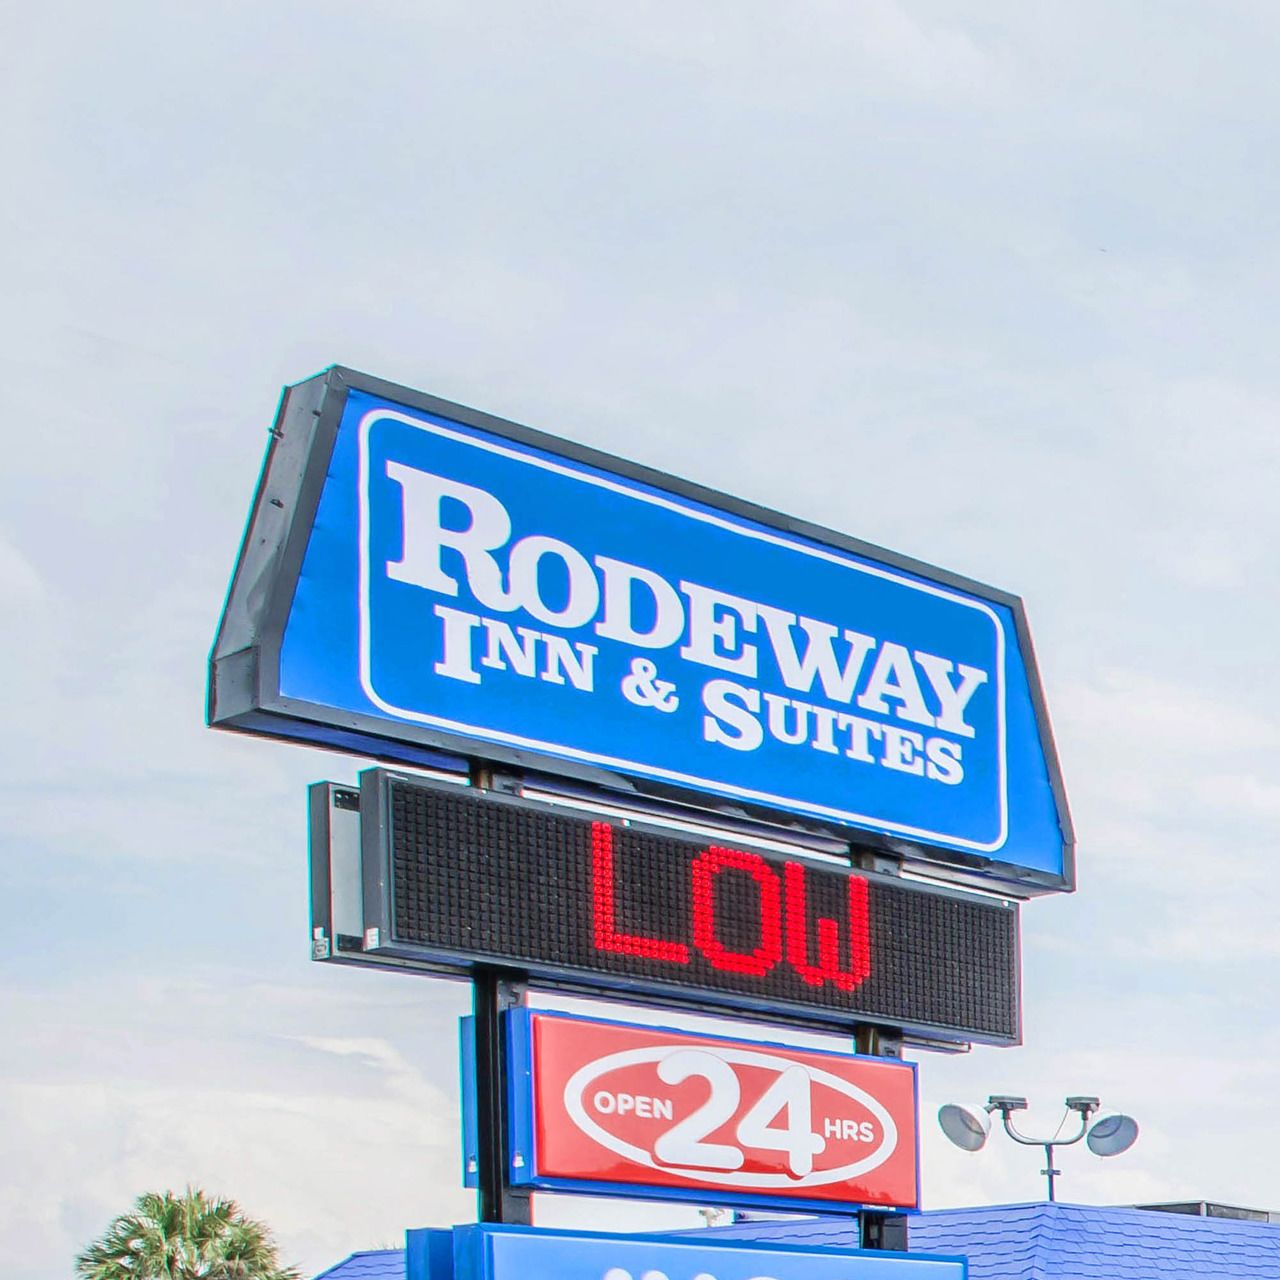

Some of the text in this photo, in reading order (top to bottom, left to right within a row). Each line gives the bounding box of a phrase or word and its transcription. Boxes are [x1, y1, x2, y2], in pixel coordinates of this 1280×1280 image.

[385, 459, 988, 738] RODEWAY
[433, 604, 964, 785] INN & SUITES
[591, 821, 870, 992] LOW
[593, 1050, 874, 1179] OPEN 24 HRS
